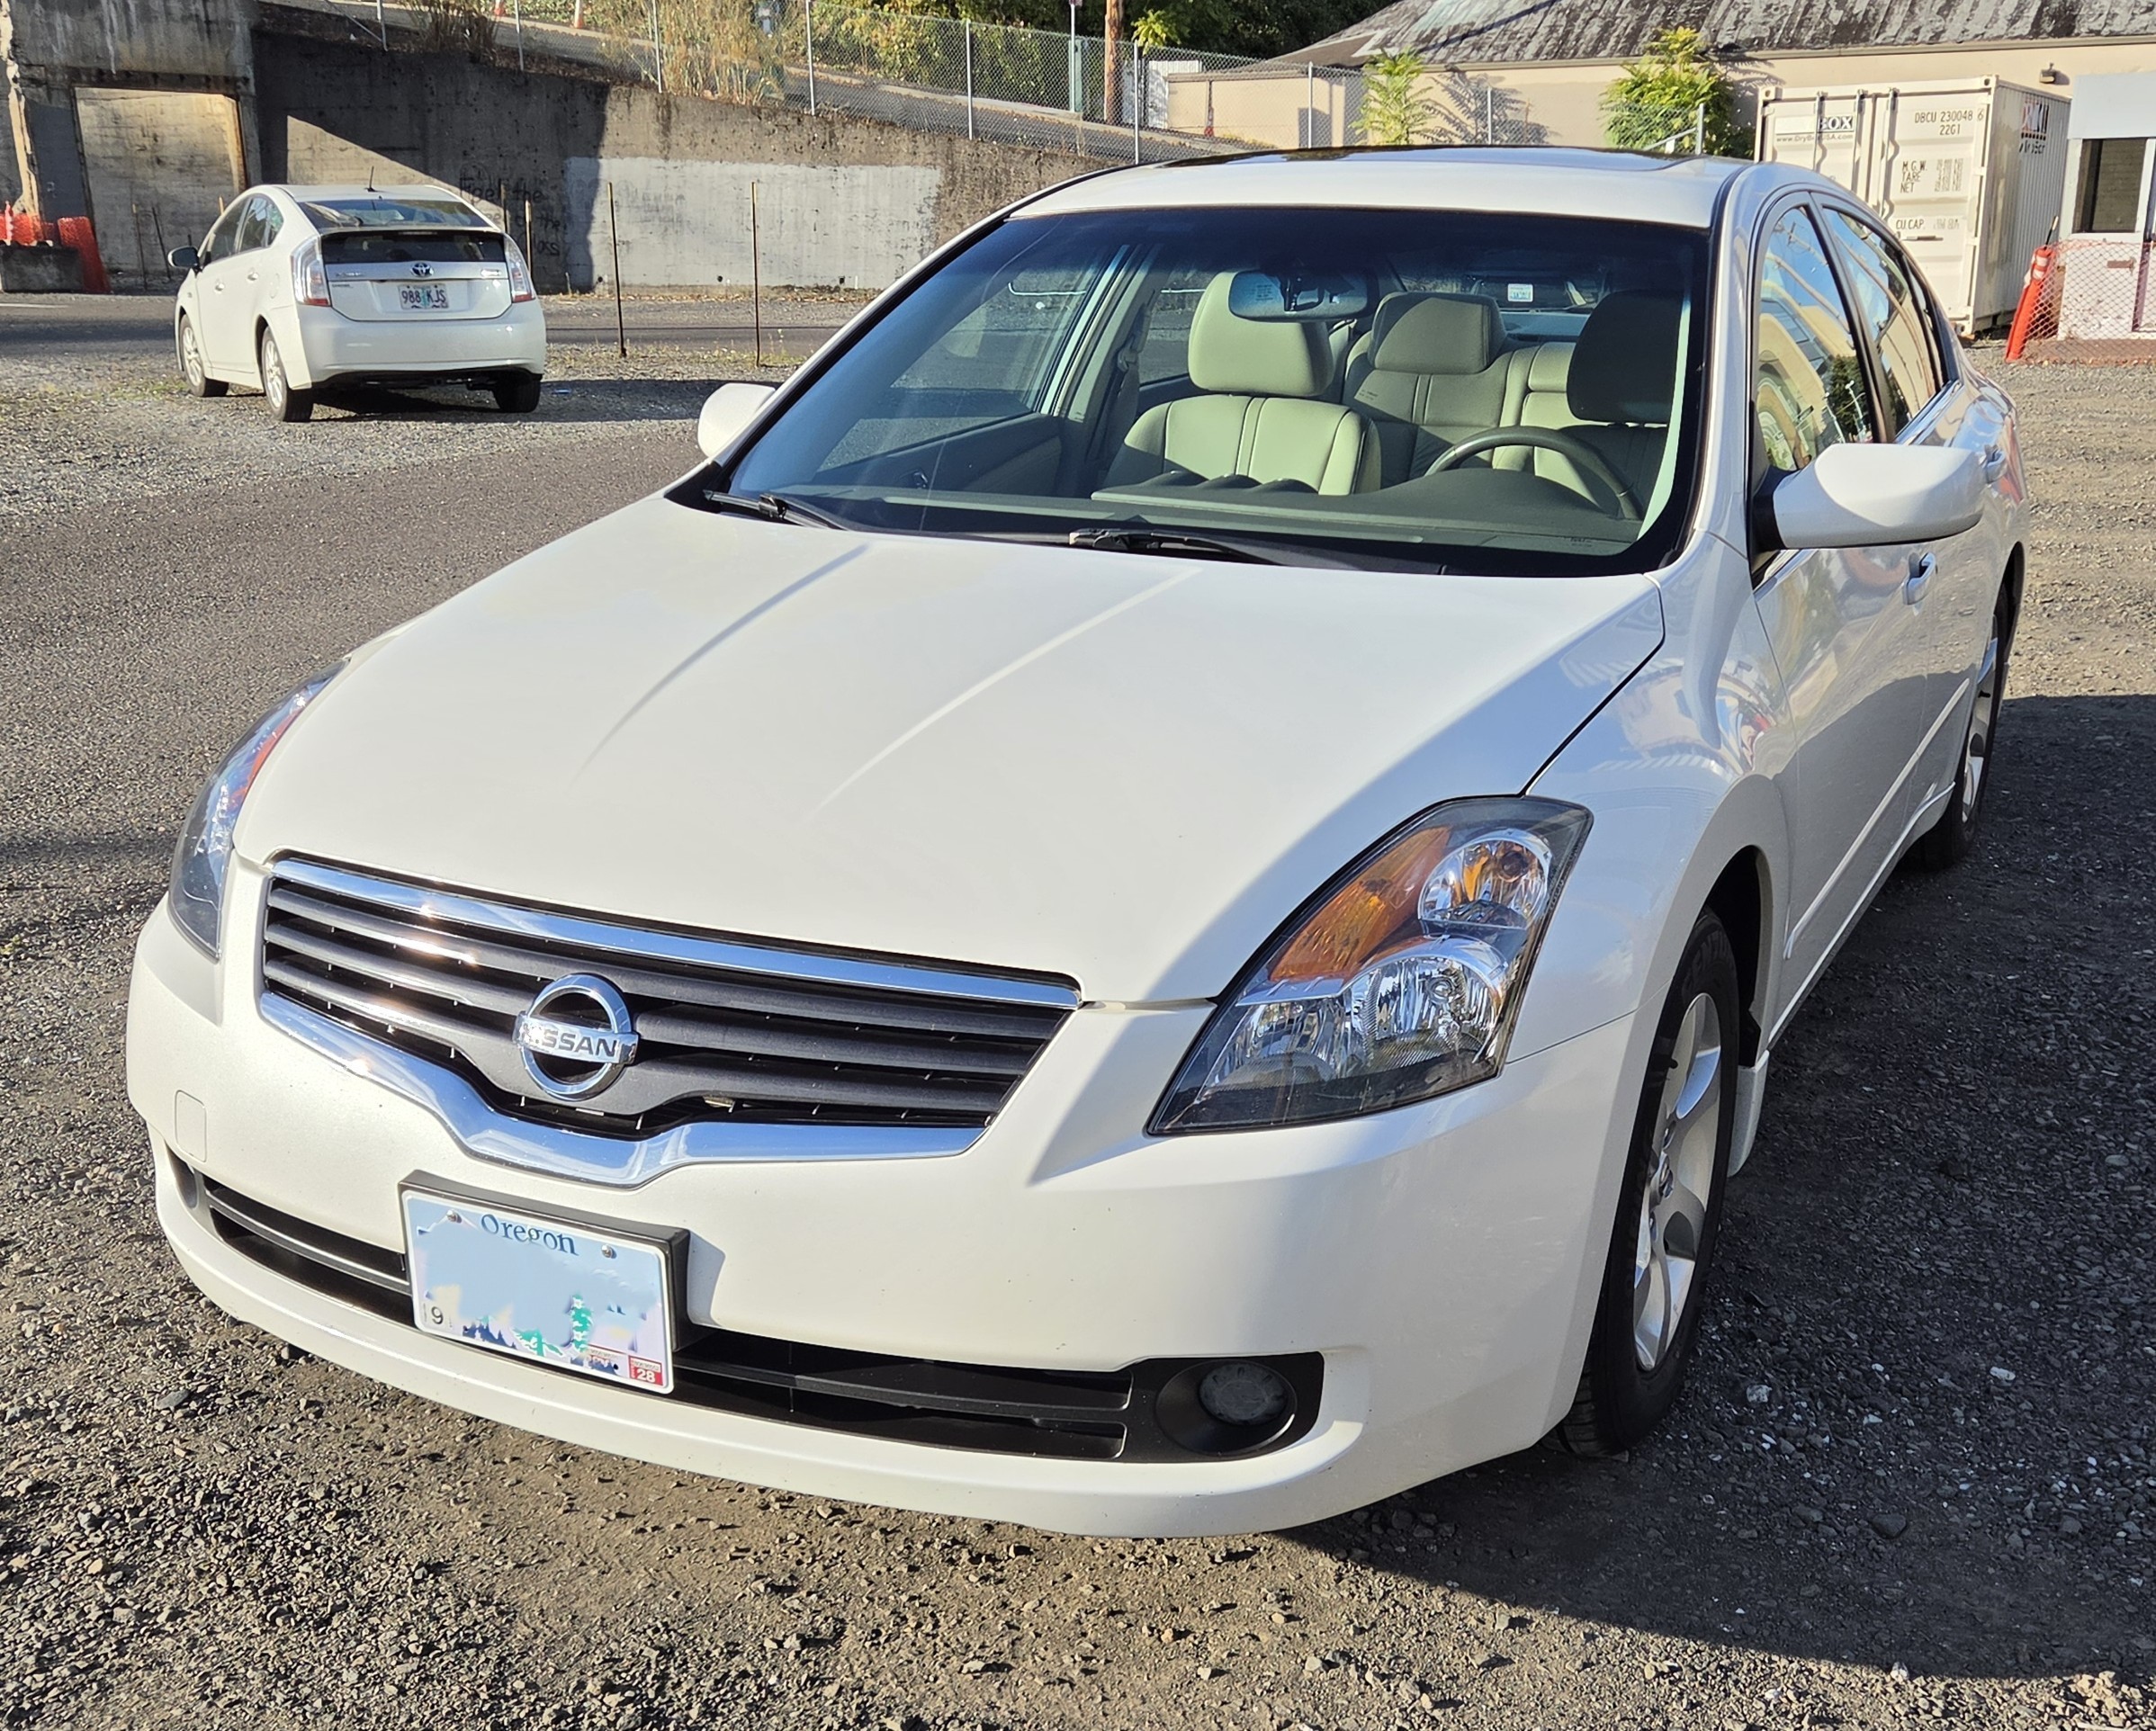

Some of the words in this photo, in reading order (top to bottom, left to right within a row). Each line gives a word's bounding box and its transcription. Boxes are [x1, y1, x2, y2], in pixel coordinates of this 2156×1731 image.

[1914, 112, 1937, 123] DBCU
[1940, 110, 1973, 122] 230048
[1977, 108, 1985, 121] 6
[1818, 116, 1854, 131] BOX
[1939, 124, 1961, 136] 22G1
[1776, 134, 1854, 142] www.DryBUSA.com
[1900, 182, 1915, 193] NET
[401, 290, 422, 304] 988
[426, 289, 446, 303] KJS
[522, 1023, 618, 1057] NSSAN
[481, 1214, 579, 1257] Oregon
[431, 1305, 444, 1325] 9
[636, 1368, 656, 1383] 28
